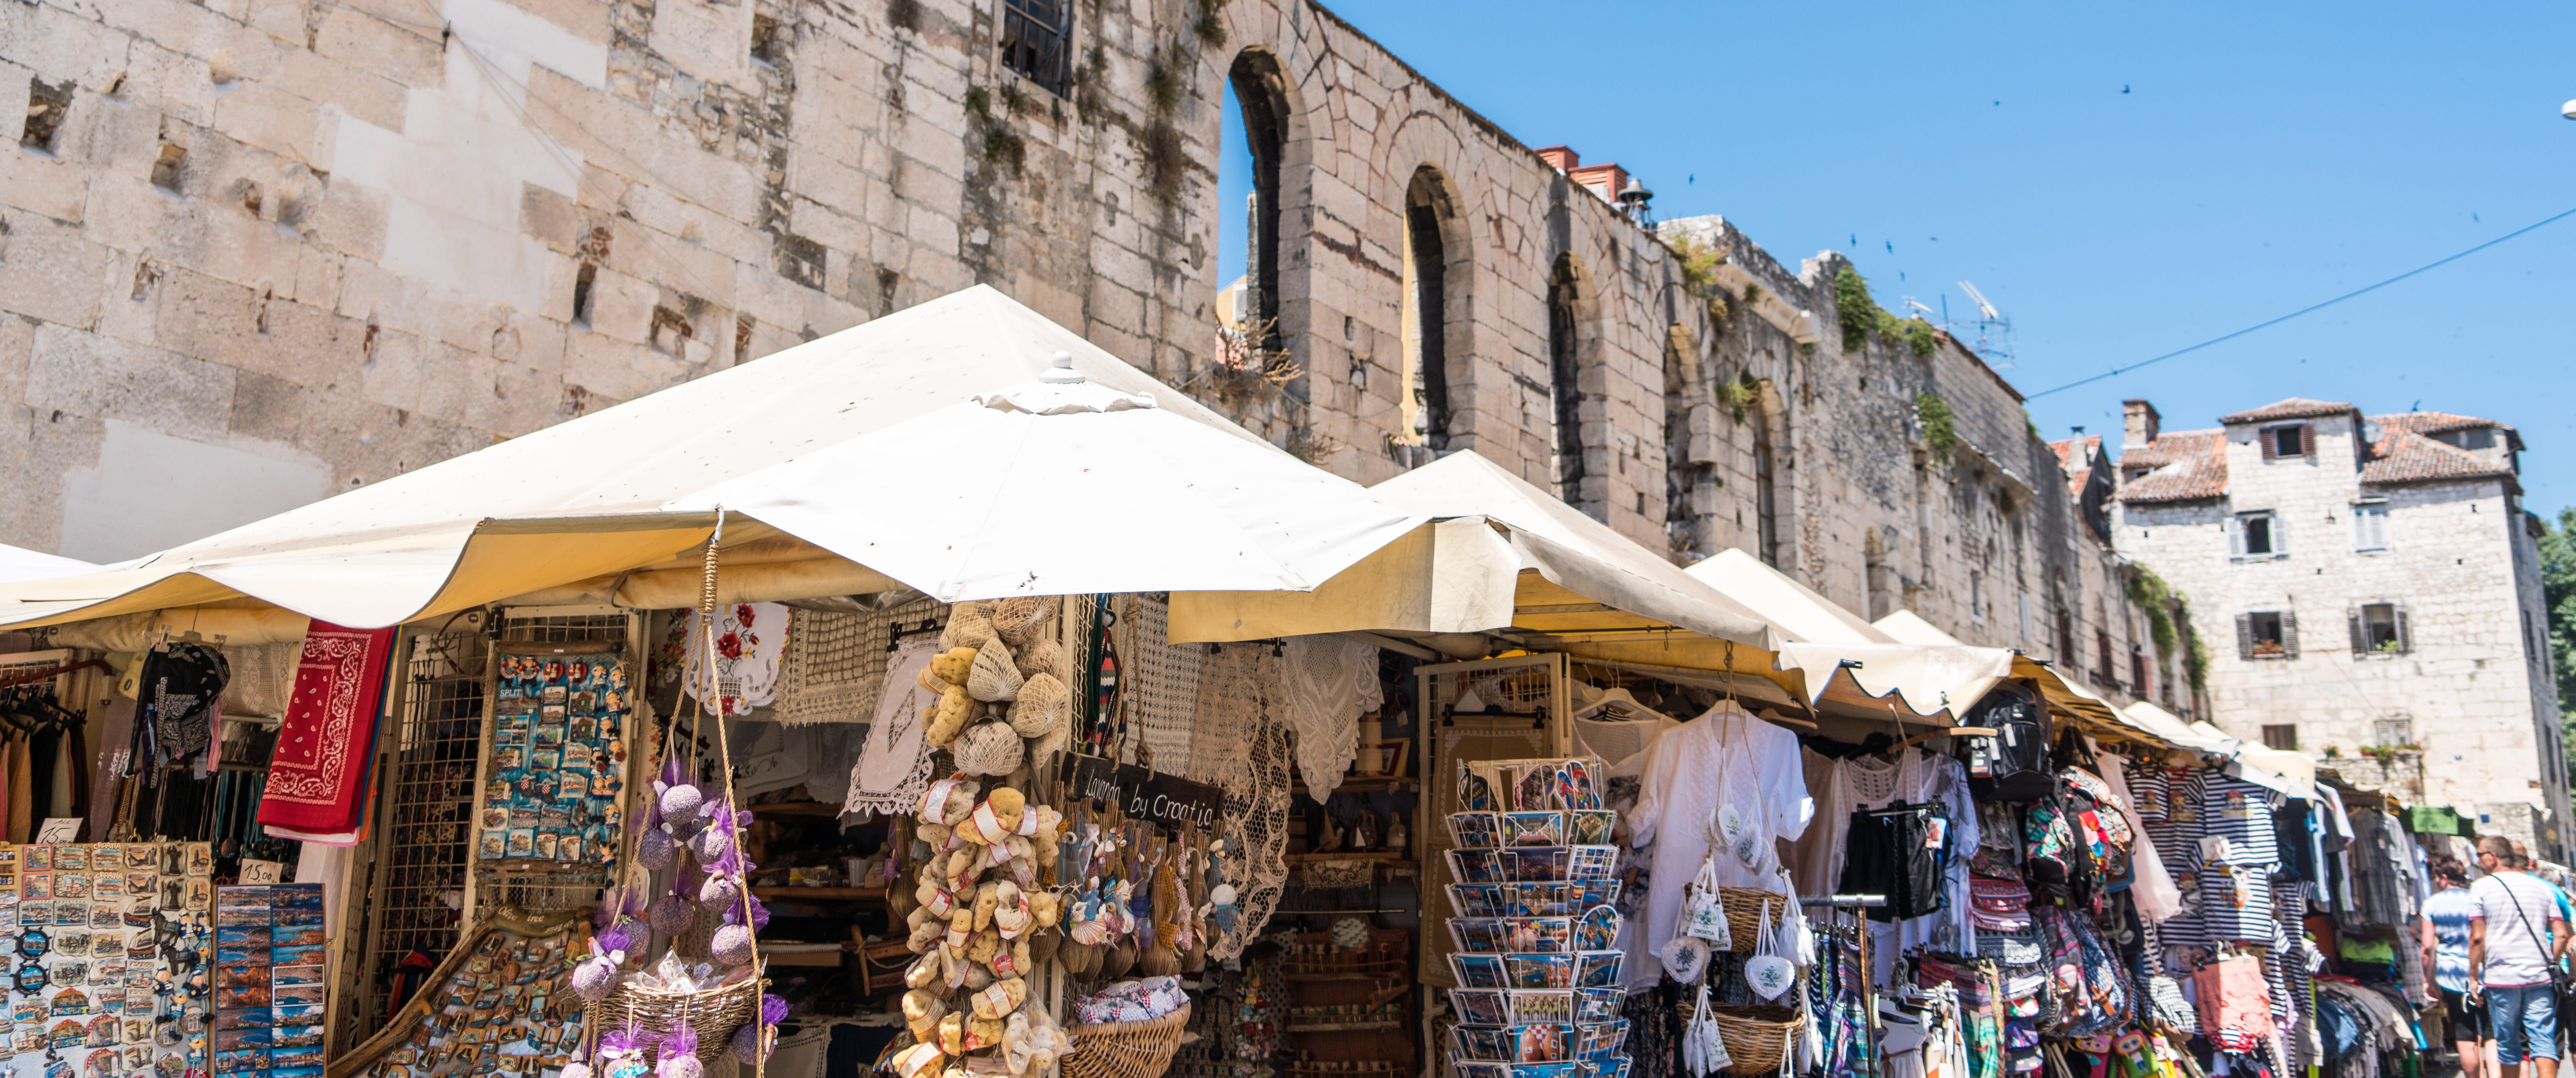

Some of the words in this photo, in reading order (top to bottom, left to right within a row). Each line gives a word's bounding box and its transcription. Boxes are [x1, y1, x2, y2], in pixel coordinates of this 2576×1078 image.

[1473, 786, 1484, 798] SPLIT
[1130, 784, 1147, 819] by
[1153, 794, 1213, 827] Croatia
[245, 864, 272, 882] 15,00
[498, 906, 518, 921] Olive
[527, 914, 544, 922] tree
[62, 1037, 87, 1047] SPLIT
